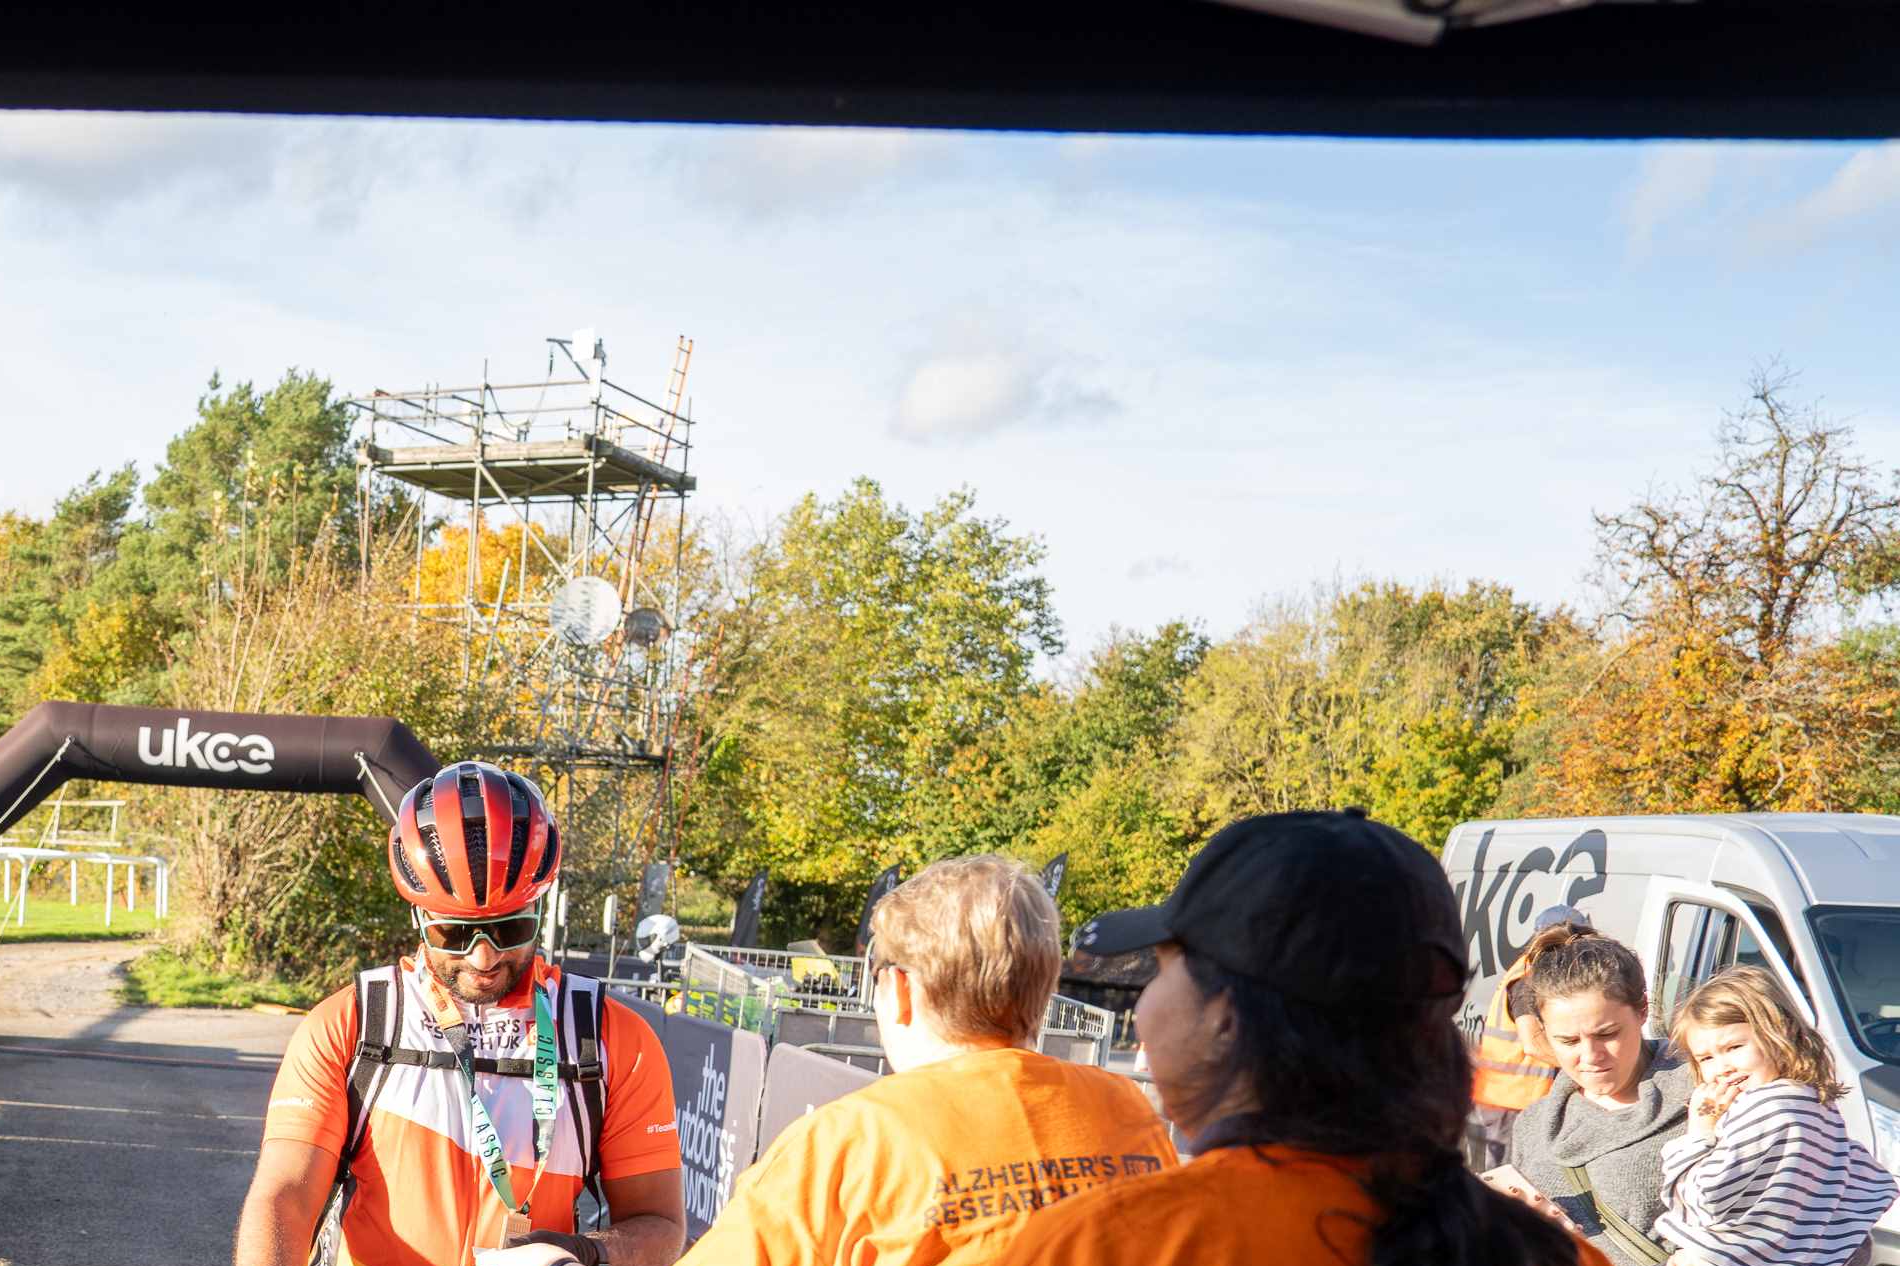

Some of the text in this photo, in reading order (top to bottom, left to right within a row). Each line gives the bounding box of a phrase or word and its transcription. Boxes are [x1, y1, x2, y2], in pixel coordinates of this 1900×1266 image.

[496, 1035, 520, 1050] UK
[535, 1034, 555, 1116] CLASSIC
[702, 1043, 726, 1120] the
[933, 1155, 1118, 1199] ALZHEIMER'S
